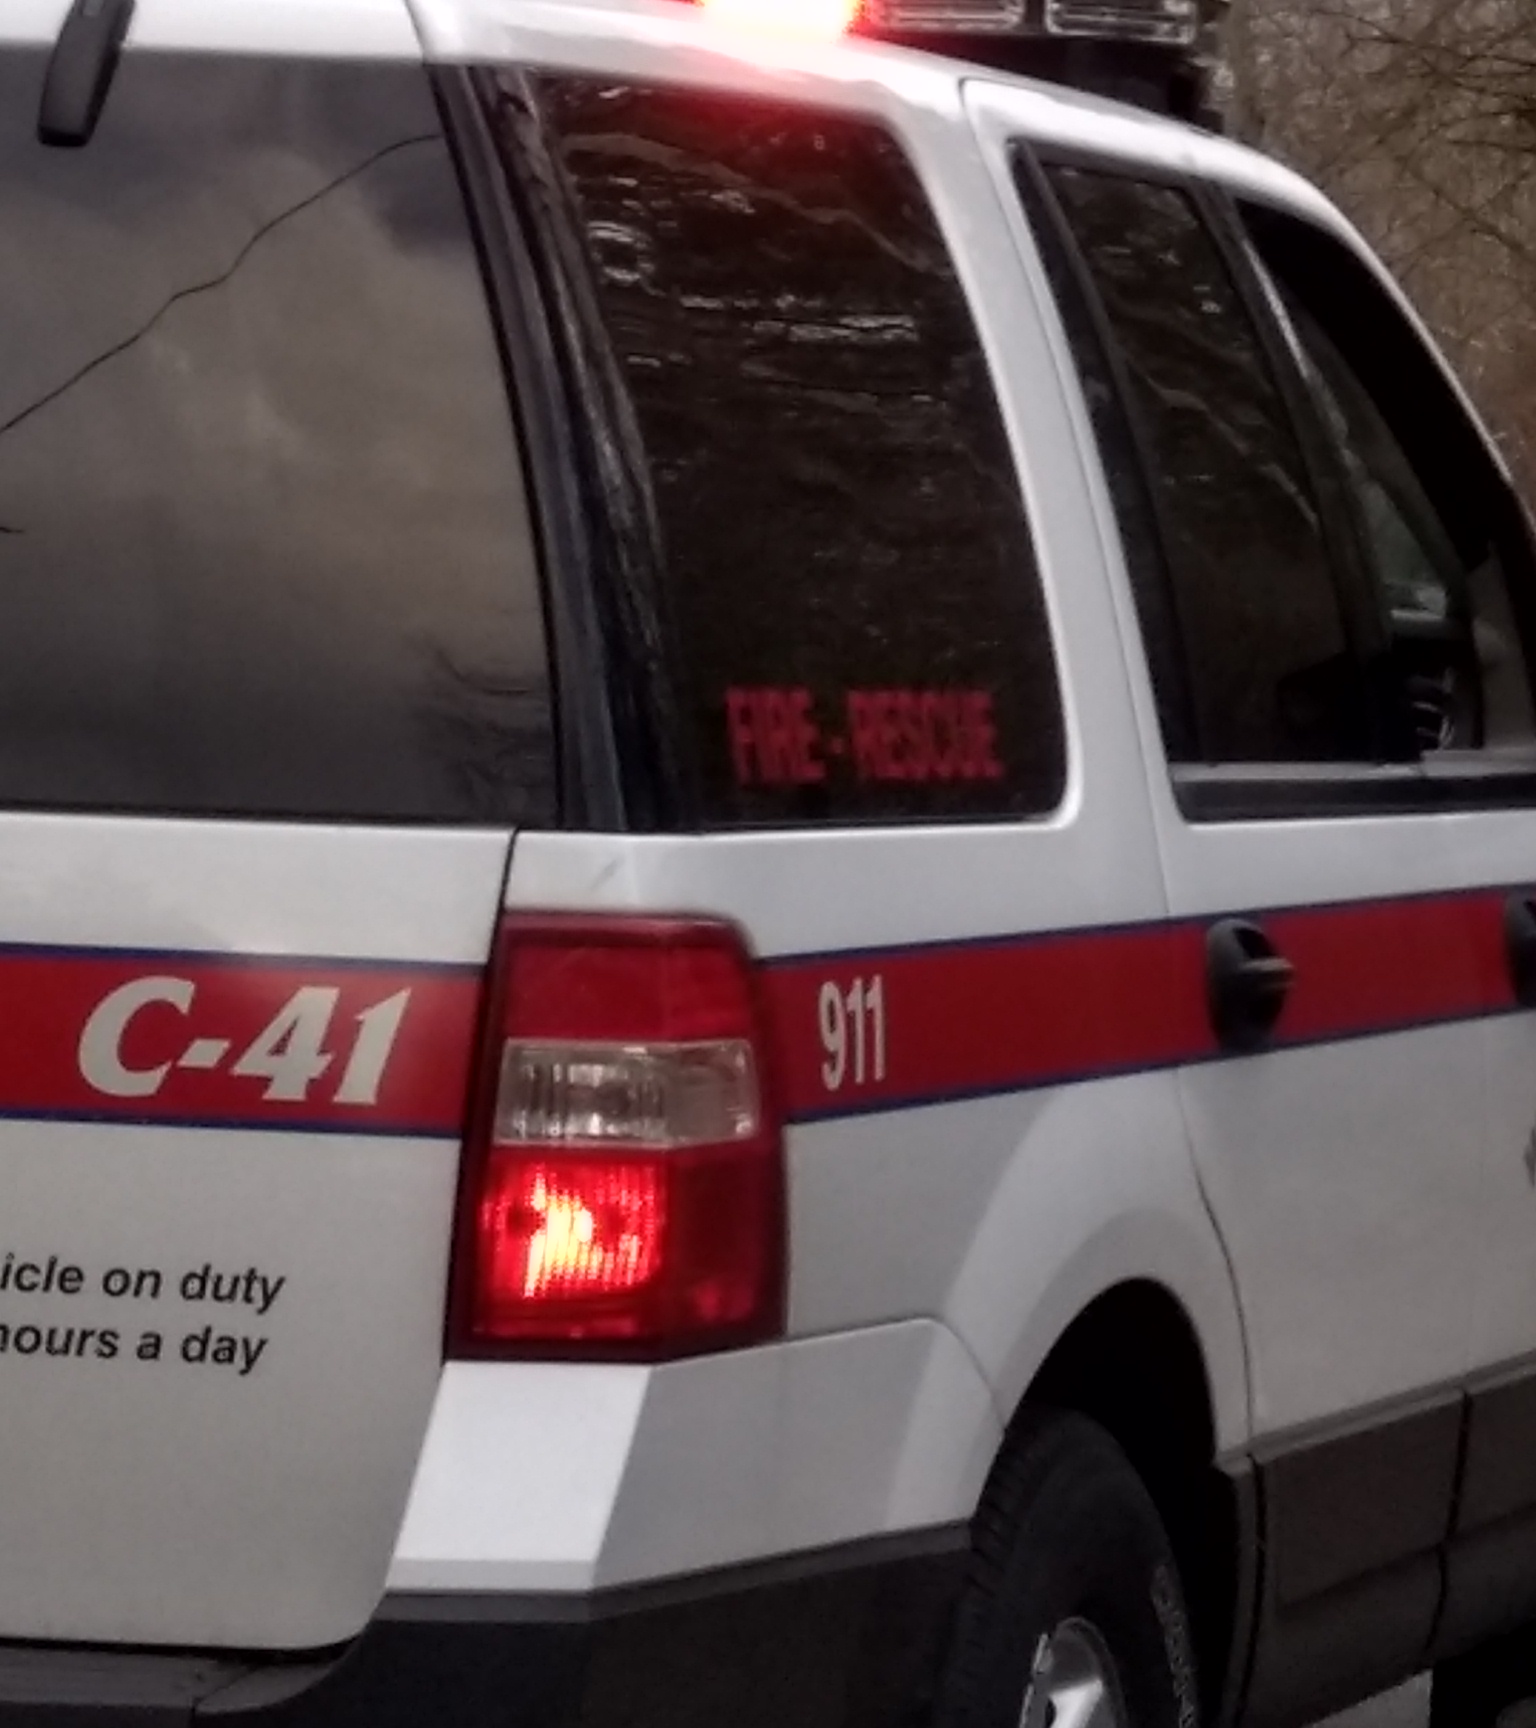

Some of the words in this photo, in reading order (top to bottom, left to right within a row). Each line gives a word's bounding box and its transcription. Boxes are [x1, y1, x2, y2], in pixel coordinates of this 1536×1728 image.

[78, 976, 412, 1105] C-41
[818, 975, 887, 1092] 911
[102, 1267, 163, 1299] on
[180, 1262, 286, 1315] duty
[136, 1330, 163, 1361] a
[180, 1324, 269, 1376] day
